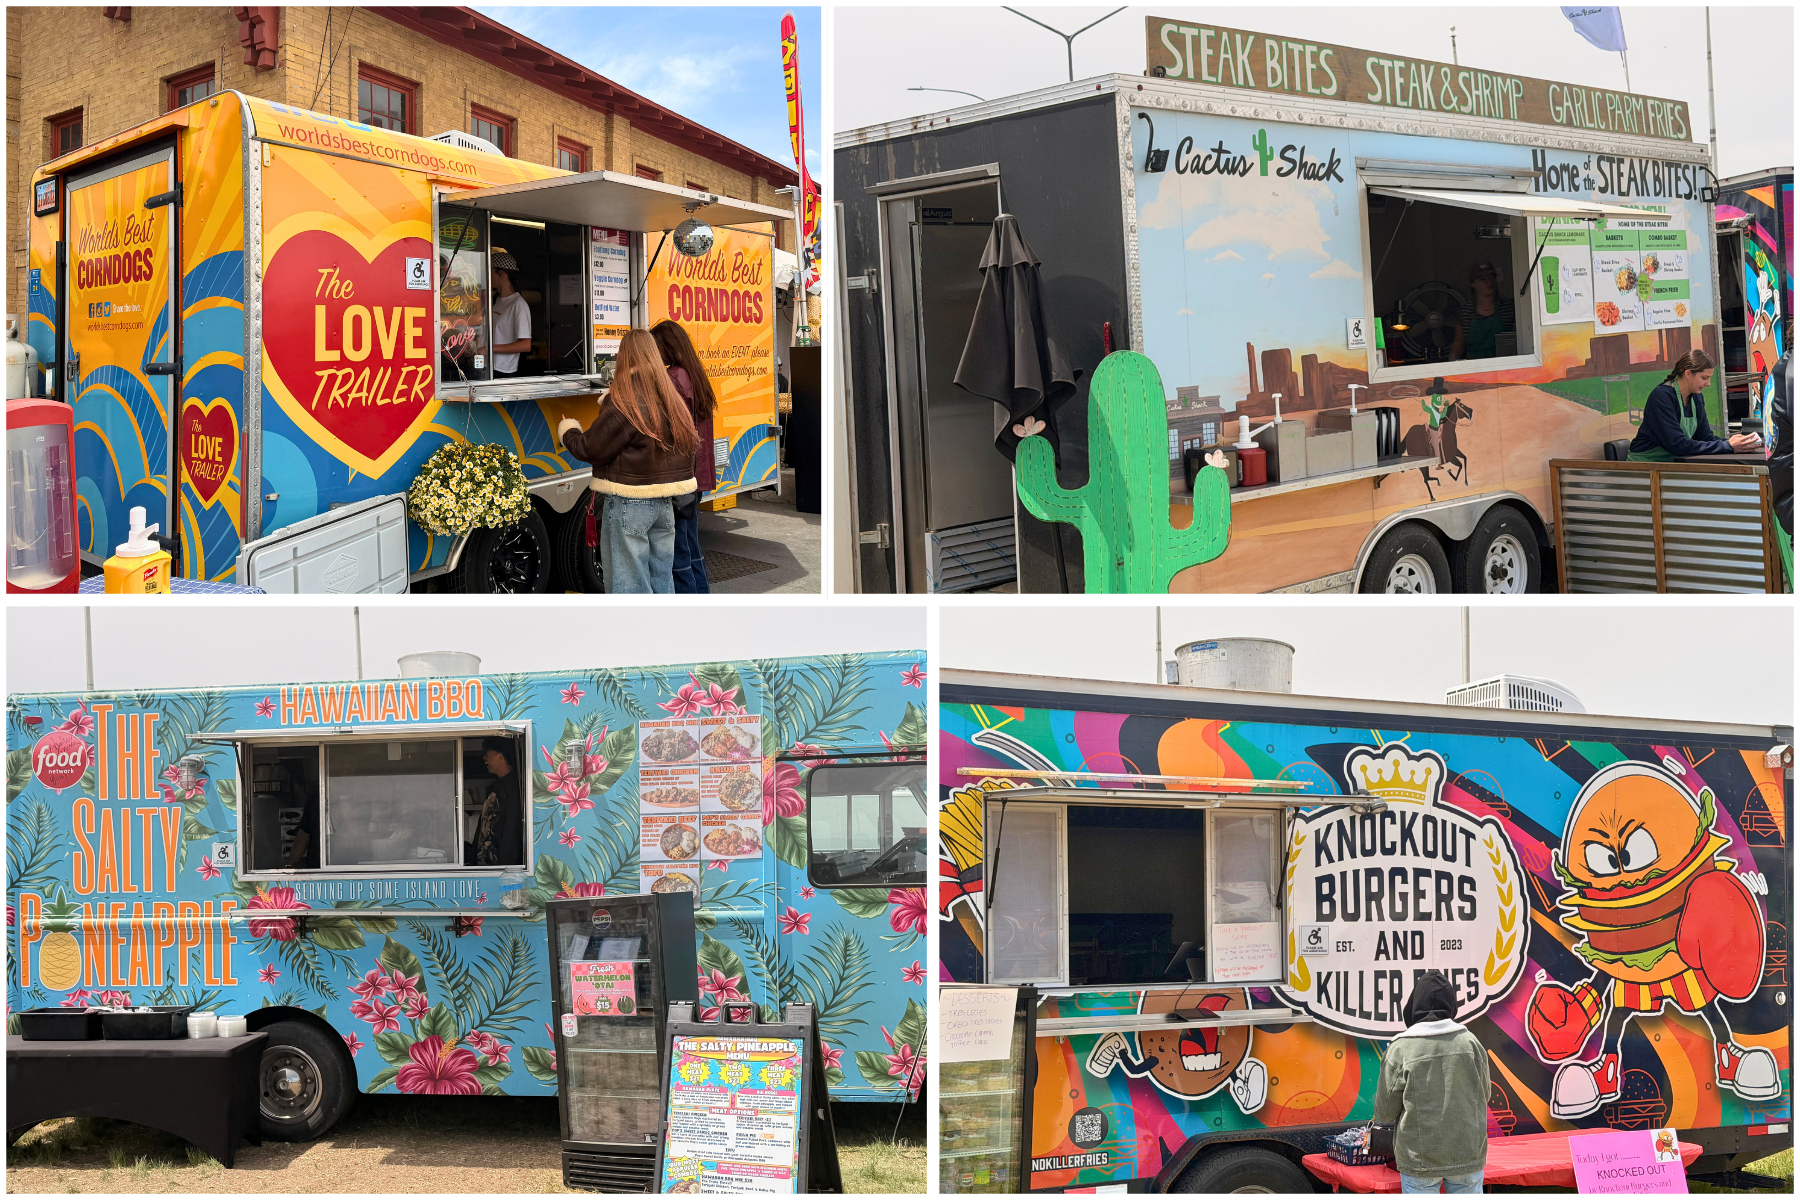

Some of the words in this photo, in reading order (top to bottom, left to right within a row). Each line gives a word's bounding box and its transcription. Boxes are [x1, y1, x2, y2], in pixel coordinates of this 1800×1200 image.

[1160, 23, 1257, 89] STEAK
[1264, 38, 1338, 97] BITES
[1365, 56, 1437, 111] STEAK
[1439, 66, 1459, 112] &
[1457, 70, 1523, 120] SHRIMP
[1548, 83, 1606, 130] GARLIC
[1606, 92, 1649, 136] PARM
[1647, 99, 1688, 141] FRIES
[278, 124, 477, 176] worldsbestcorndogs.com
[1174, 136, 1255, 178] Cactus
[1276, 144, 1345, 184] Shack
[1531, 148, 1581, 193] Home
[1583, 154, 1593, 171] of
[1582, 173, 1596, 191] the
[1596, 155, 1651, 197] STEAK
[1652, 160, 1698, 201] BITES!
[930, 209, 952, 218] Argus
[124, 211, 155, 246] Best
[592, 228, 608, 241] MENU
[78, 248, 154, 290] CORNDOGS
[731, 251, 763, 286] Best
[315, 267, 355, 299] The
[667, 283, 764, 324] CORNDOGS
[314, 304, 427, 362] LOVE
[731, 345, 751, 359] EVENT
[311, 364, 433, 411] TRAILER
[191, 419, 202, 432] The
[191, 434, 223, 462] LOVE
[190, 460, 225, 482] TRAILER
[280, 682, 420, 726] HAWAIIAN
[427, 679, 485, 720] BBQ
[700, 717, 727, 726] SWEET
[736, 716, 760, 724] SALTY
[36, 745, 84, 777] food
[91, 703, 162, 800] THE
[48, 767, 75, 775] network
[640, 769, 669, 777] TERIYAKI
[670, 768, 699, 776] CHICKEN
[709, 765, 735, 774] KALUA
[642, 816, 677, 824] TERIYAKI
[678, 815, 697, 823] BEEF
[72, 797, 182, 895] SALTY
[1314, 810, 1477, 868] KNOCKOUT
[643, 869, 664, 877] TOFU
[295, 882, 344, 901] SERVING
[350, 882, 363, 901] UP
[369, 882, 399, 900] SOME
[406, 881, 447, 899] ISLAND
[453, 880, 481, 898] LOVE
[1314, 866, 1477, 922] BURGERS
[1335, 940, 1356, 953] EST.
[1374, 930, 1425, 961] AND
[1440, 939, 1463, 950] 2023
[574, 974, 632, 982] WATERMELON
[589, 963, 615, 975] Fresh
[596, 1001, 610, 1010] $15
[1316, 970, 1404, 1022] KILLER
[678, 1041, 698, 1051] THE
[700, 1041, 734, 1052] SALTY
[736, 1042, 796, 1053] PINEAPPLE
[725, 1052, 750, 1060] MENU
[672, 1164, 699, 1173] POPULAR
[1031, 1152, 1108, 1172] NDKILLERFRIES
[1575, 1153, 1600, 1166] Today
[673, 1170, 700, 1179] COMBOS!
[1597, 1166, 1645, 1180] KNOCKED
[1647, 1164, 1666, 1175] OUT
